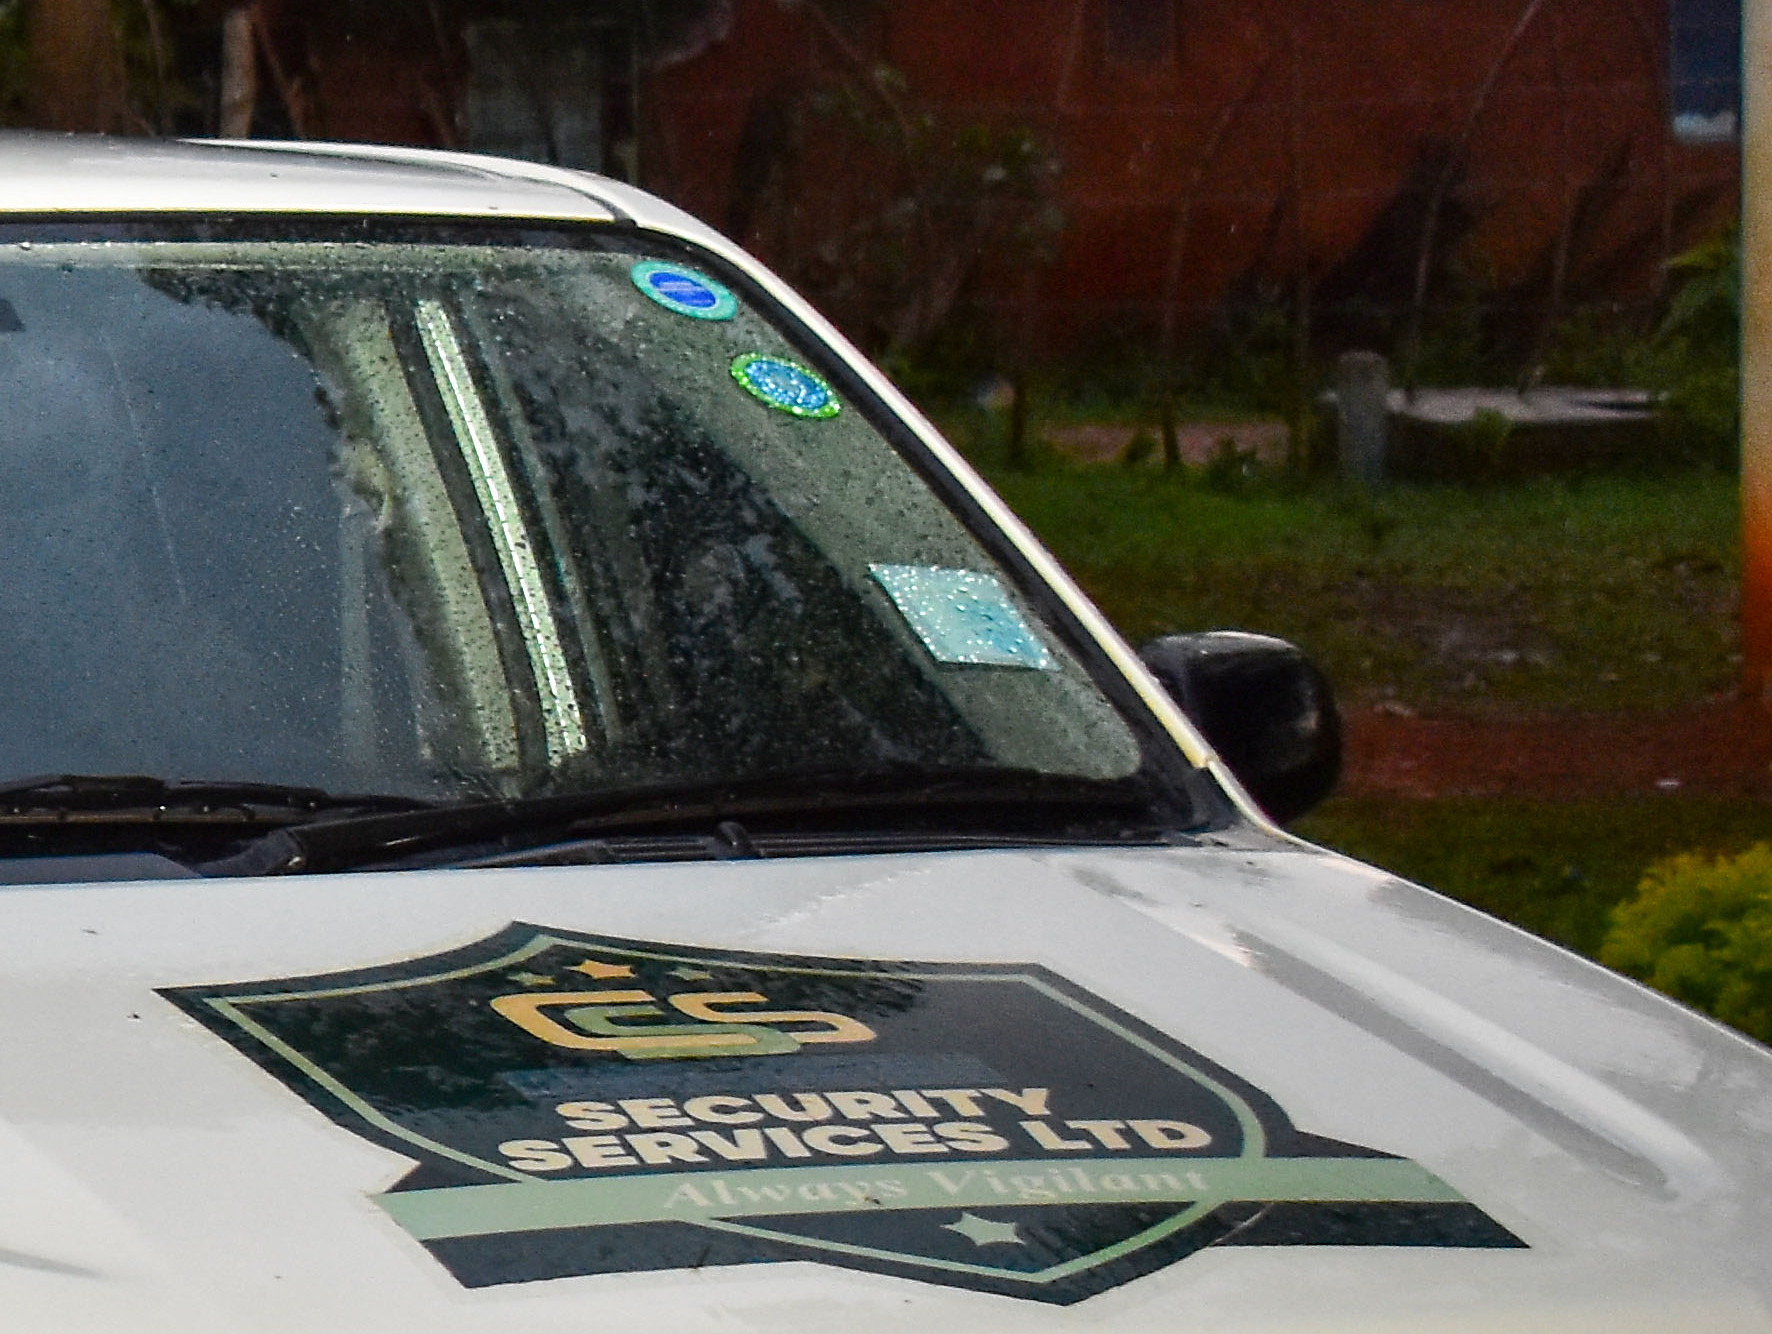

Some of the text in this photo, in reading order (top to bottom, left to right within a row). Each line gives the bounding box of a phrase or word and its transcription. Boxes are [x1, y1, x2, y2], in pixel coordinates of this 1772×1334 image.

[555, 1087, 1051, 1131] SECURITY
[497, 1118, 1213, 1171] SERVICES LTD
[663, 1166, 1211, 1209] Always Vigilant
